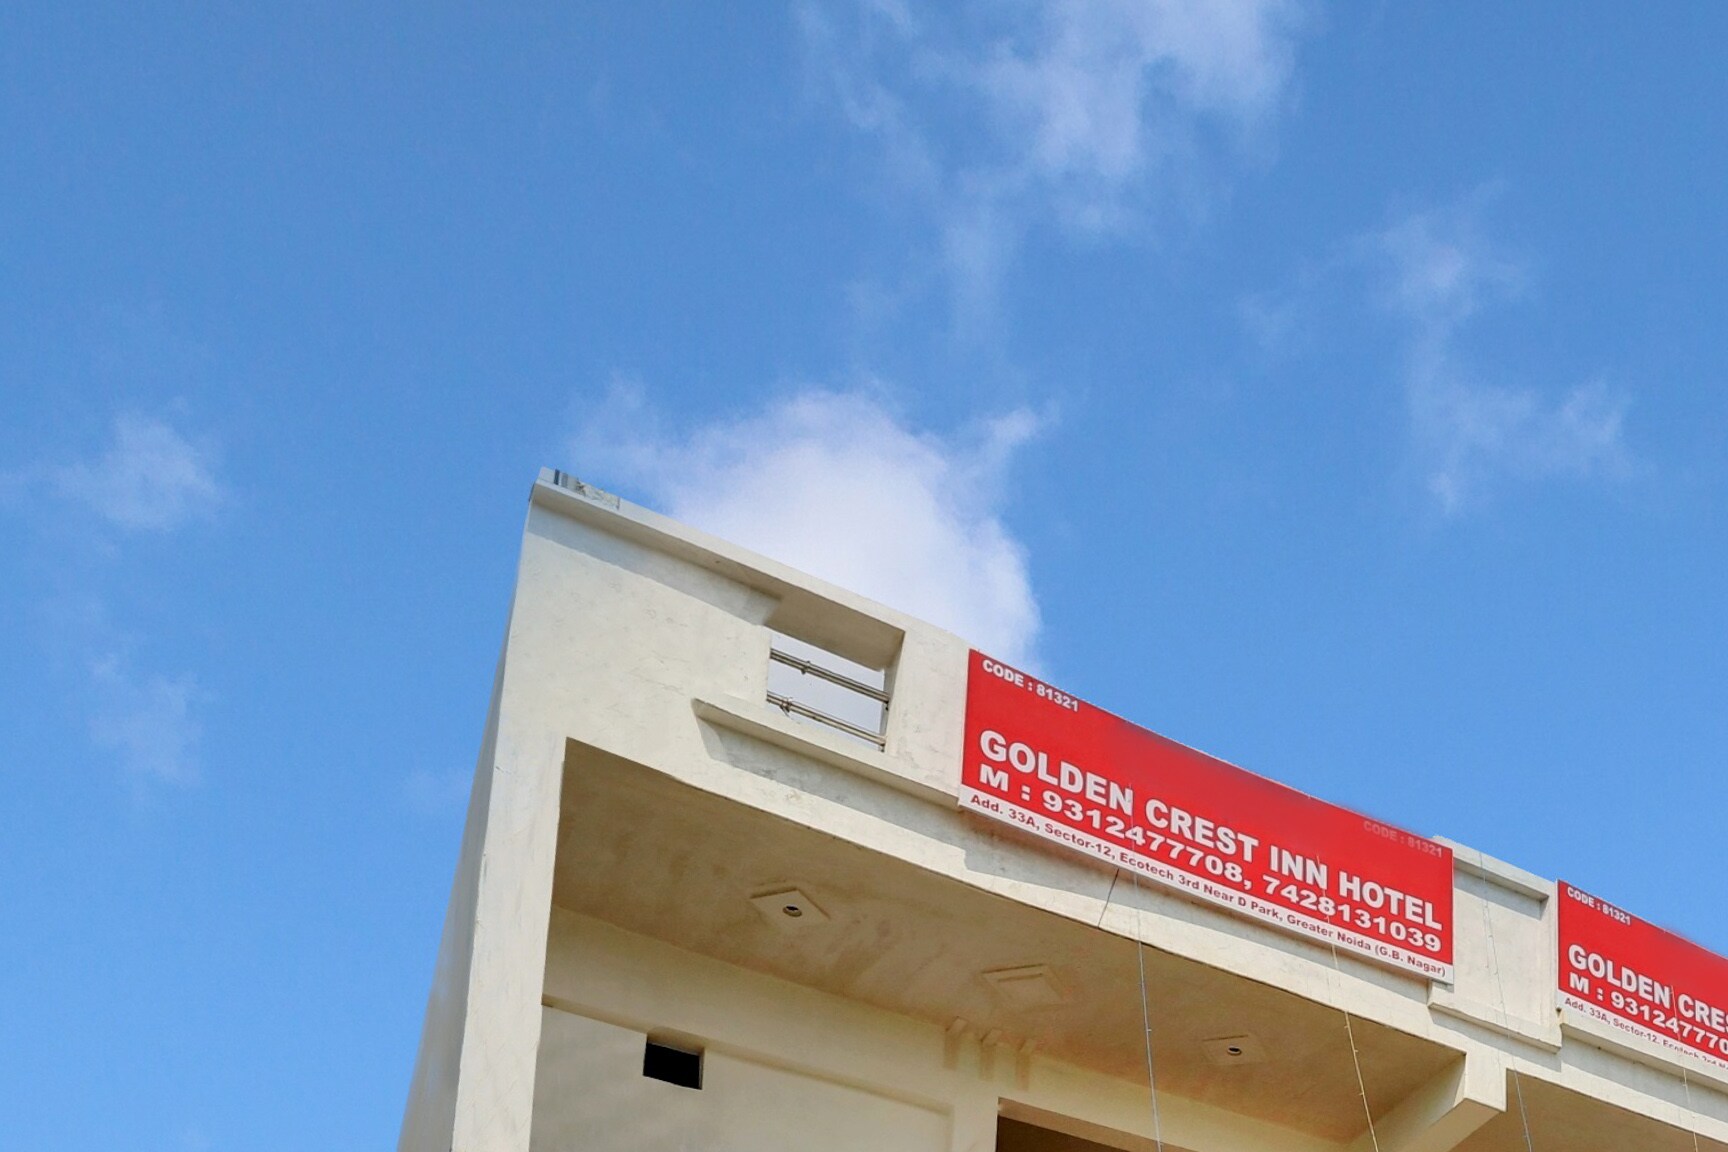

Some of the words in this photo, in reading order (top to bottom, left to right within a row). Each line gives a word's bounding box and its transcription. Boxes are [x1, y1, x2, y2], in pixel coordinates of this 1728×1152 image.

[982, 659, 1024, 687] CODE
[1036, 683, 1079, 712] 81321
[980, 730, 1134, 817] GOLDEN
[1145, 799, 1259, 863] CREST
[1270, 845, 1328, 890] INN
[1339, 871, 1443, 931] HOTEL
[1363, 820, 1398, 842] CODE
[1407, 836, 1442, 858] 81321
[979, 763, 1009, 792] M
[1021, 785, 1031, 801] :
[1042, 790, 1252, 890] 9312477708,
[1263, 874, 1442, 952] 7428131039
[971, 795, 1004, 815] Add.
[1008, 808, 1040, 831] 33A,
[1044, 822, 1116, 860] Sector-12,
[1120, 851, 1174, 881] Ecotech
[1178, 874, 1200, 890] 3rd
[1204, 884, 1234, 903] Near
[1238, 896, 1247, 907] D
[1251, 901, 1283, 922] Park,
[1287, 914, 1334, 938] Greater
[1337, 931, 1371, 951] Noida
[1375, 944, 1404, 962] (G.B.
[1407, 955, 1446, 977] Nagar)
[1567, 886, 1595, 908] CODE
[1602, 903, 1631, 926] 81321
[1568, 944, 1671, 1009] GOLDEN
[1569, 972, 1589, 994] M
[1597, 987, 1604, 1001] :
[1564, 997, 1586, 1013] Add.
[1589, 1007, 1611, 1025] 33A,
